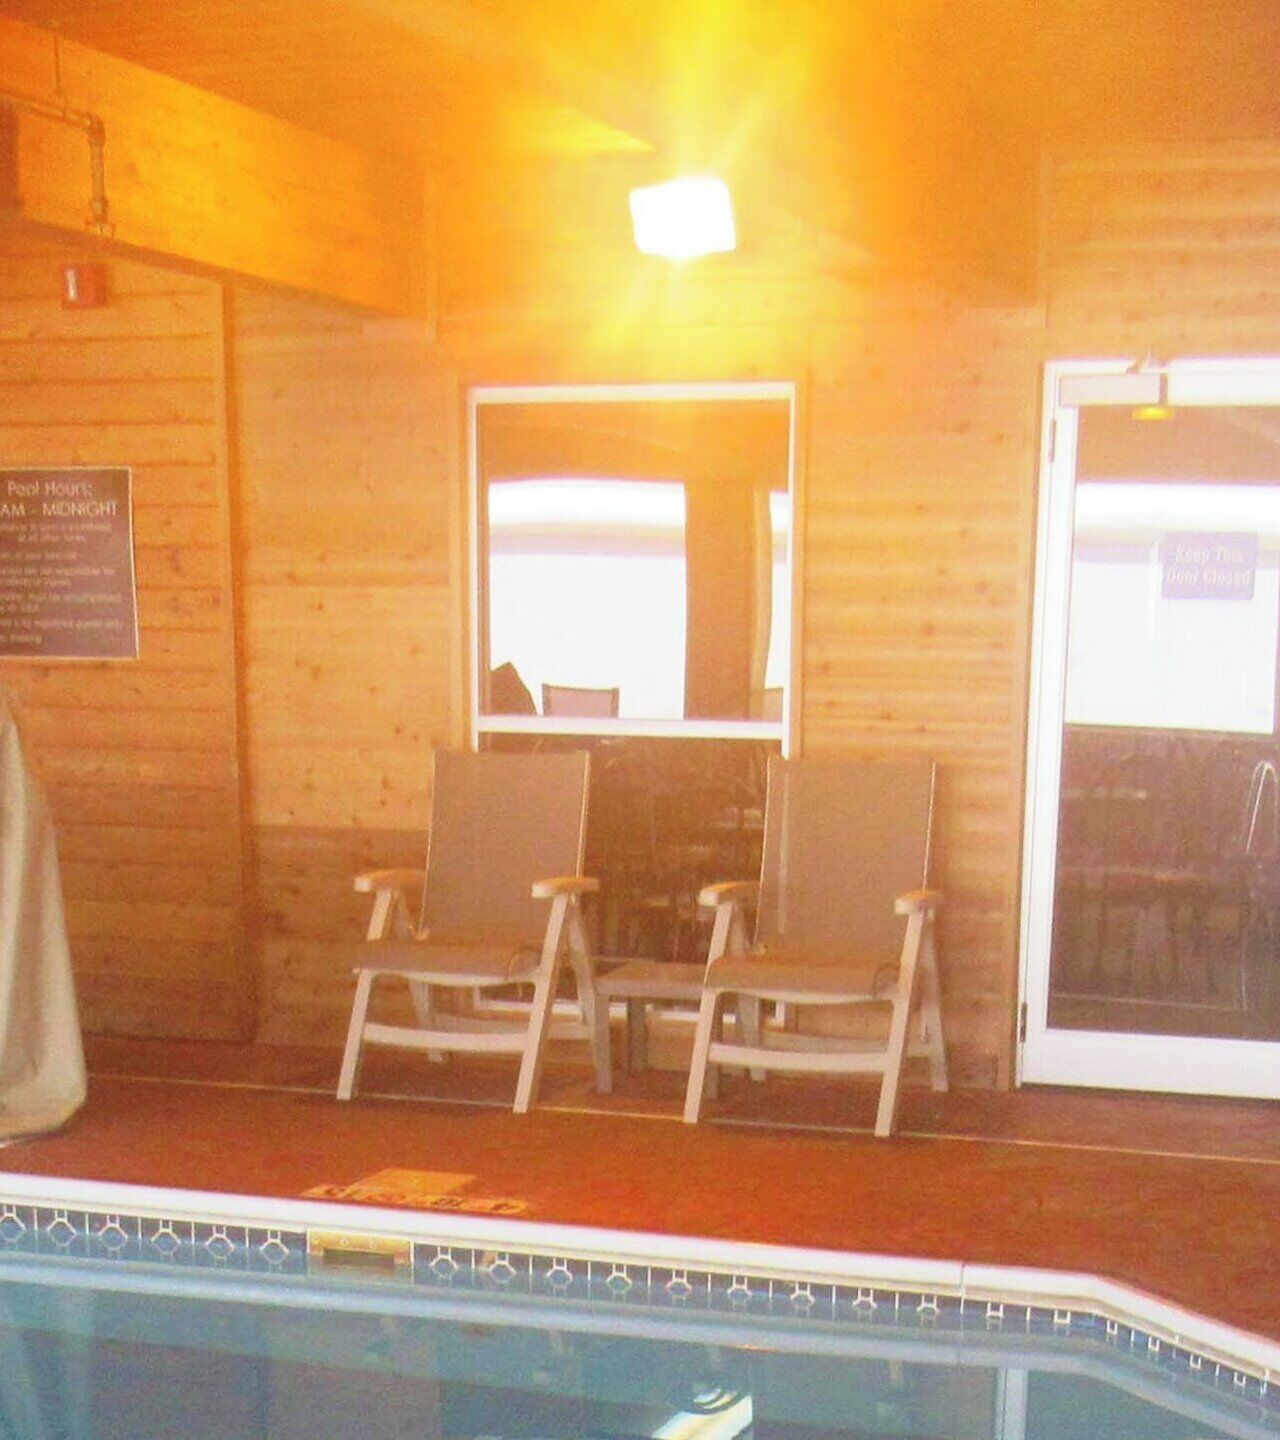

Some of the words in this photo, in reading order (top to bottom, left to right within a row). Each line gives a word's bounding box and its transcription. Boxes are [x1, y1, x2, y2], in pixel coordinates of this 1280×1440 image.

[7, 480, 39, 496] Pool
[44, 480, 93, 496] Hours:
[0, 502, 26, 518] AM
[41, 500, 118, 517] MIDNIGHT
